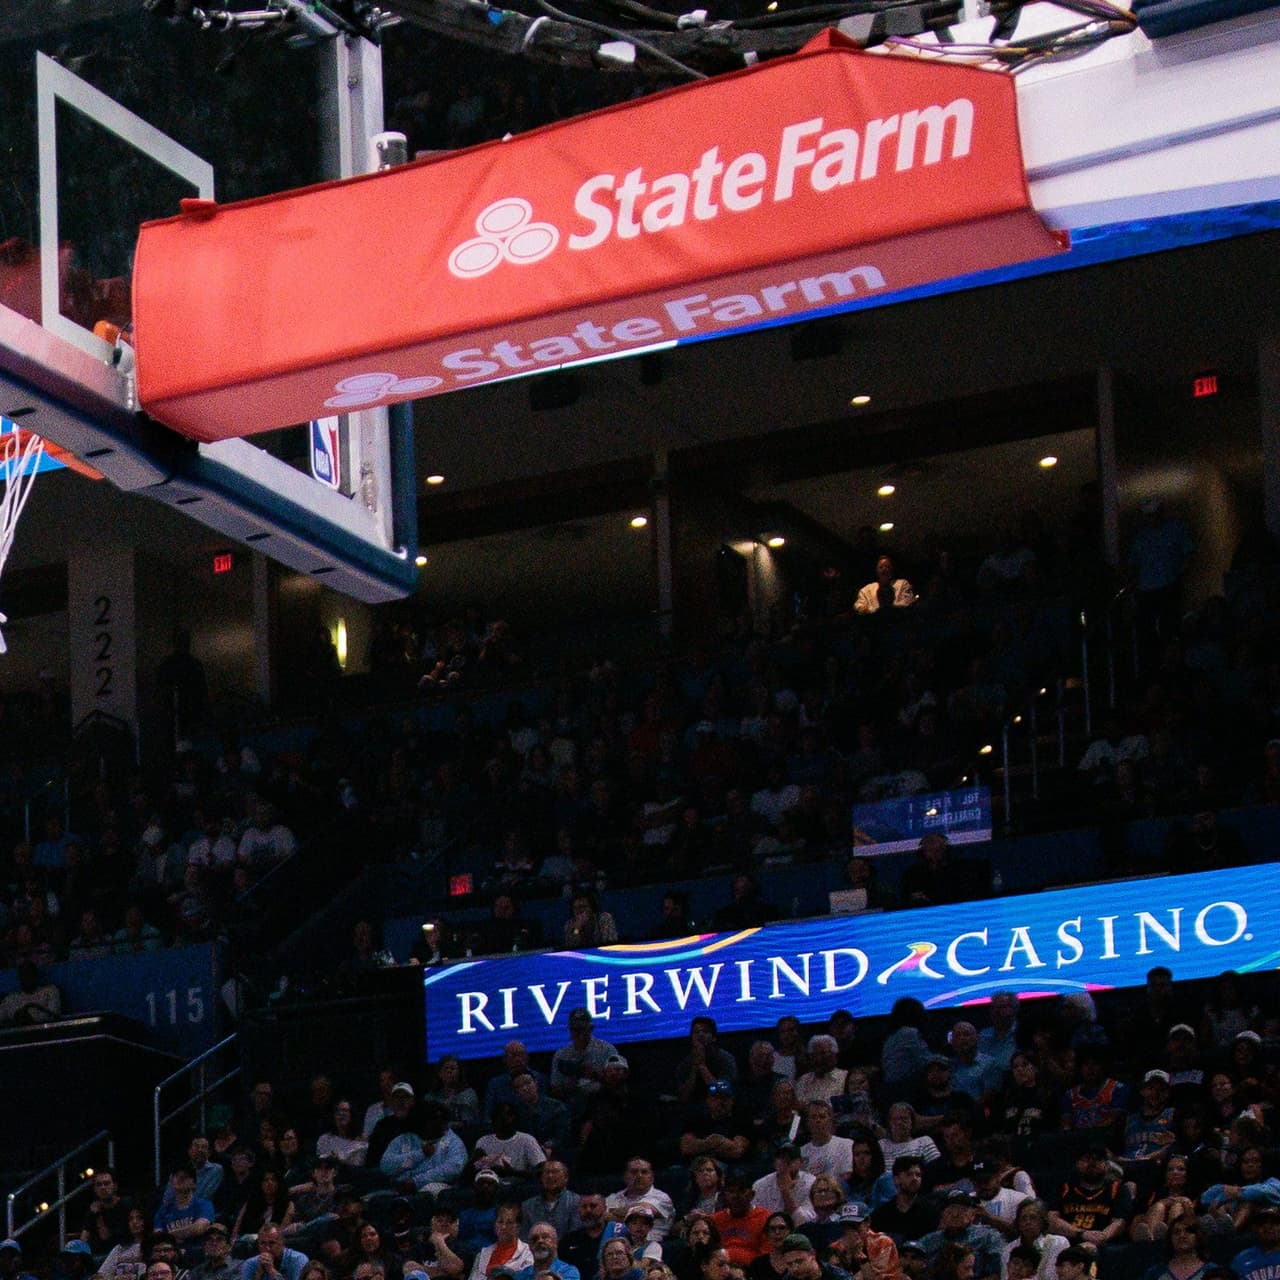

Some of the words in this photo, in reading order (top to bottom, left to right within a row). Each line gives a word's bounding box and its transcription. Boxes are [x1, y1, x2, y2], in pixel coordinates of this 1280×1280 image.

[568, 146, 766, 250] State
[774, 98, 974, 201] Farm
[441, 314, 664, 381] State
[664, 264, 886, 332] Farm
[146, 986, 204, 1027] 115
[457, 947, 869, 1033] RIVERWIND
[946, 901, 1248, 976] CASINO
